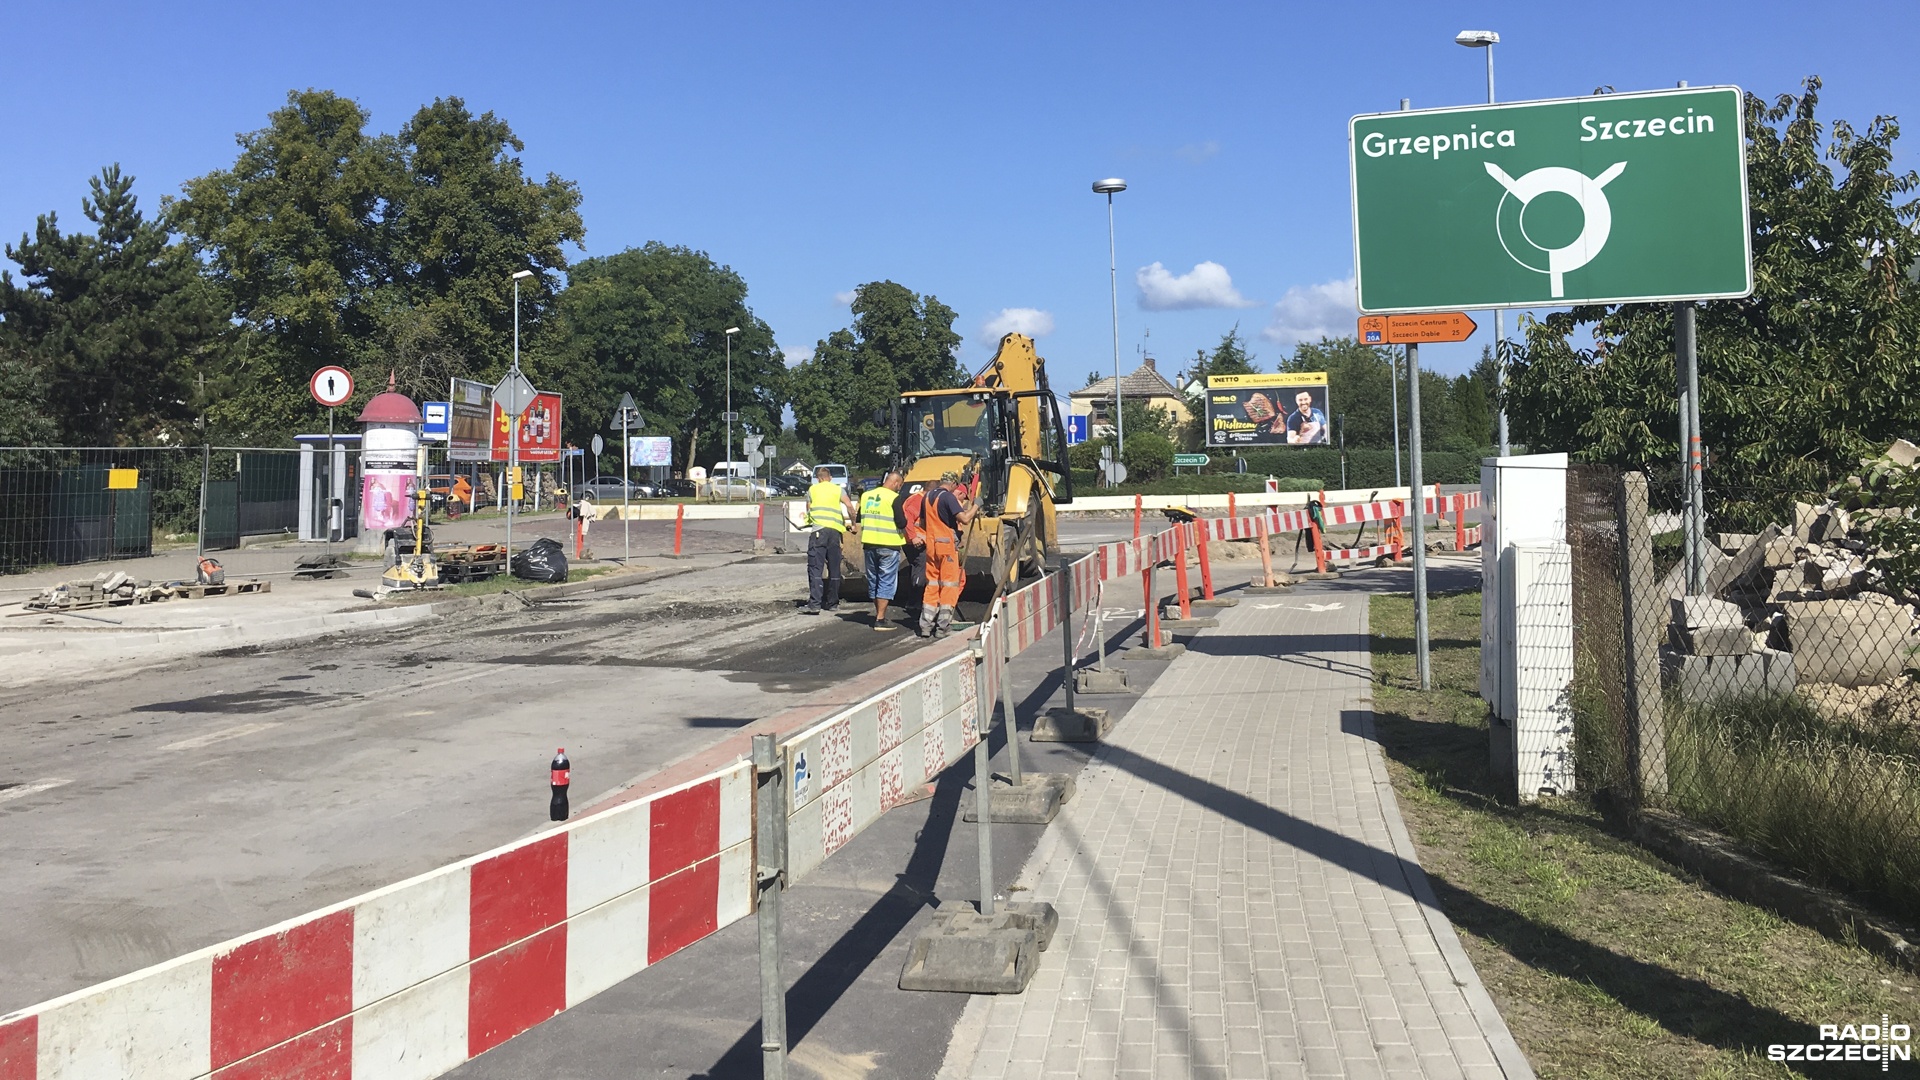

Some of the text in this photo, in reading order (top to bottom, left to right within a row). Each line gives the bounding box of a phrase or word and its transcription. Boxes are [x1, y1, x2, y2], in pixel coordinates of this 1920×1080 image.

[1580, 108, 1714, 142] Szczecin
[1362, 124, 1516, 160] Grzepnica
[1392, 319, 1418, 327] Szczecin
[1392, 330, 1418, 338] Szczecin
[1213, 418, 1258, 431] Mistrzem
